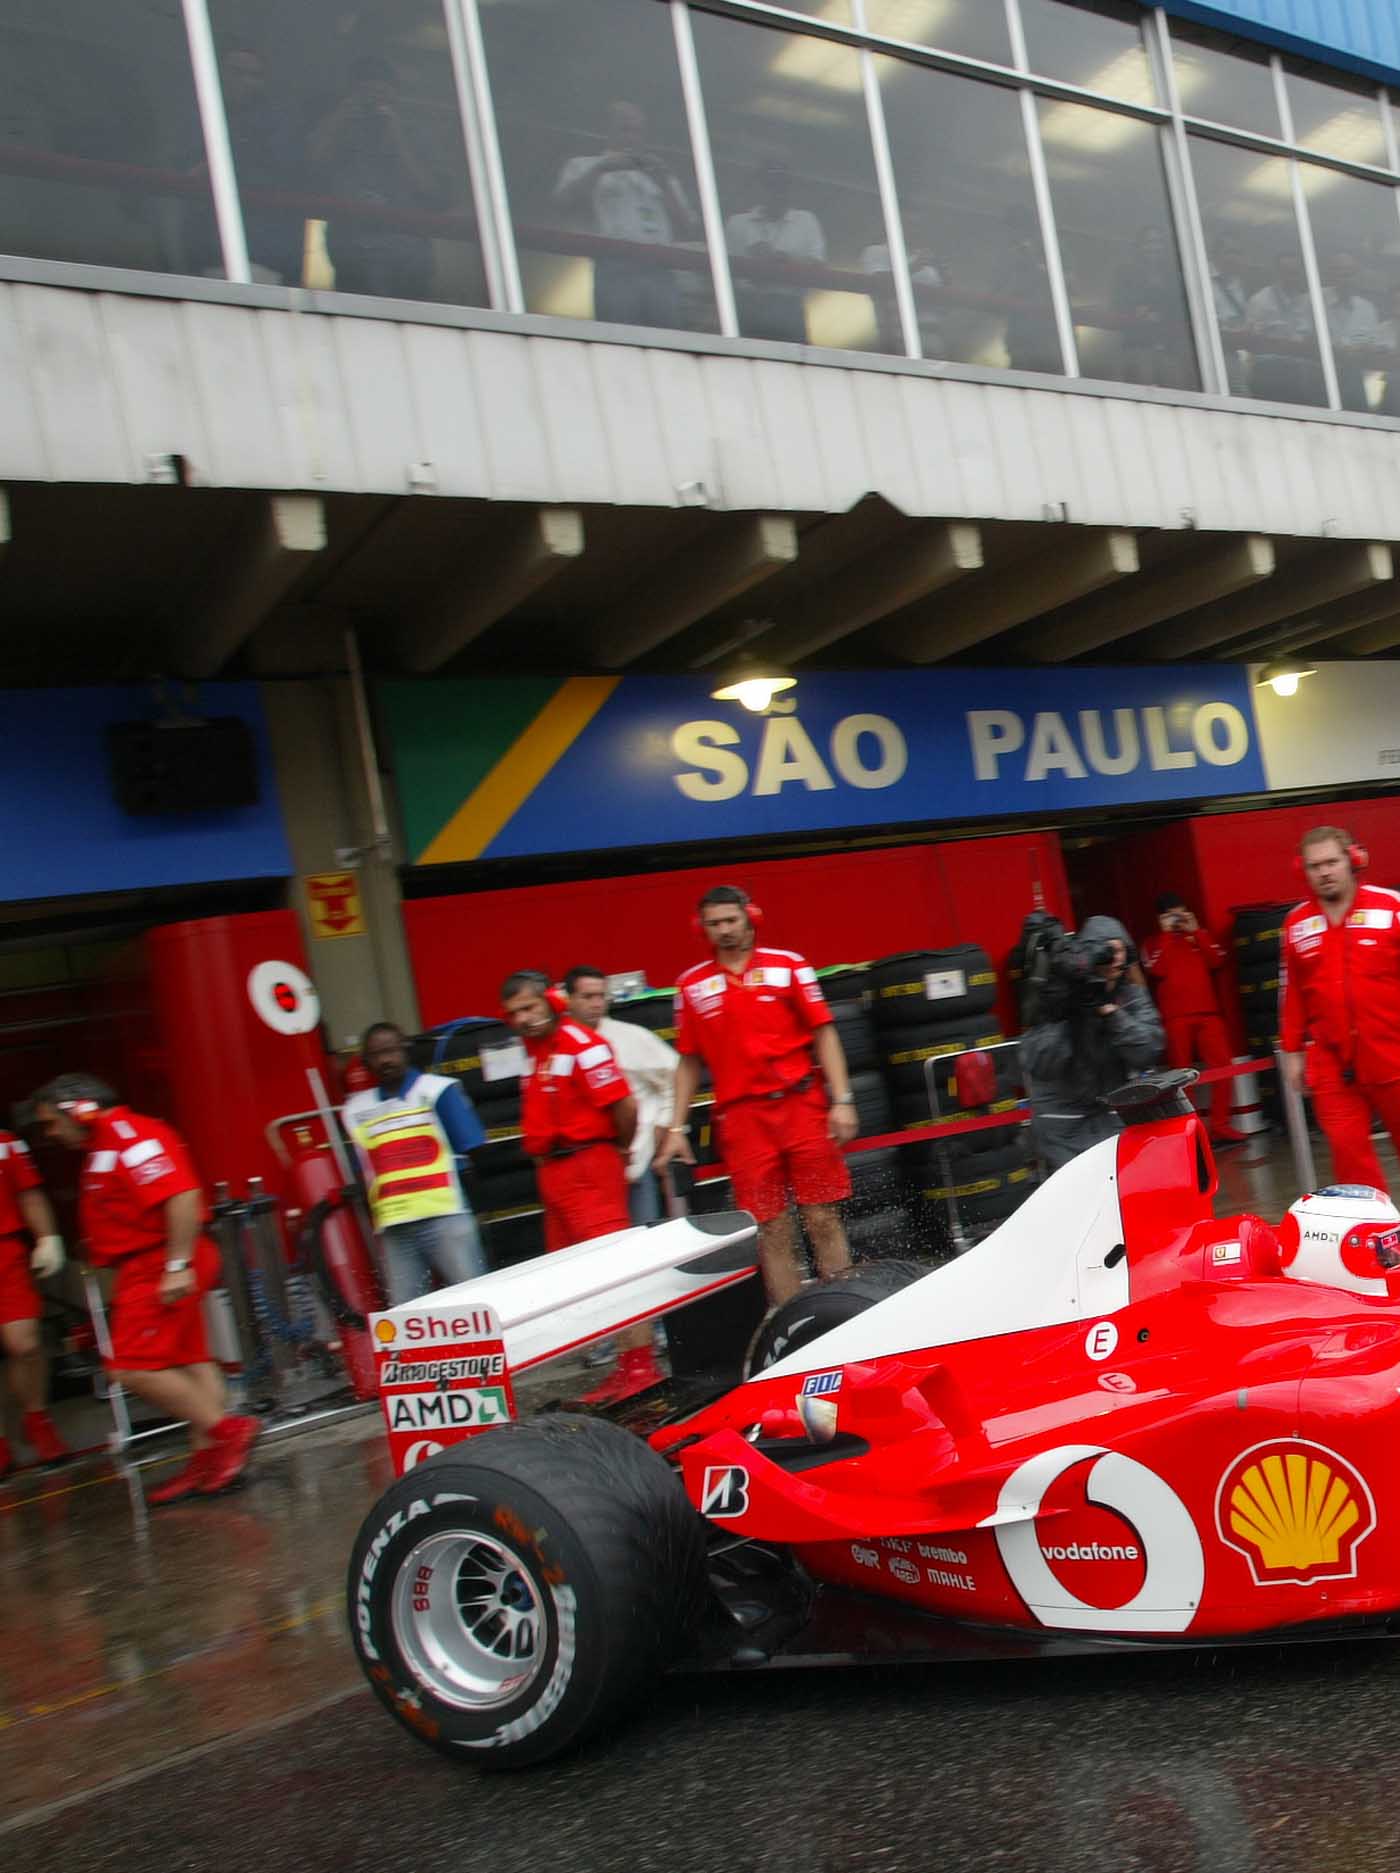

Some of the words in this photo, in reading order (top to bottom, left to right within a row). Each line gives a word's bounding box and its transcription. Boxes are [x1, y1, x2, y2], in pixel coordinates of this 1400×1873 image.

[671, 697, 908, 802] SÃO
[966, 702, 1249, 782] PAULO
[404, 1310, 493, 1341] Shell
[1093, 1328, 1110, 1354] E
[383, 1356, 503, 1385] BRIDGESTONE
[393, 1394, 473, 1429] AMD
[916, 1541, 969, 1565] brembo
[1040, 1541, 1139, 1560] vodafone
[357, 1499, 432, 1661] POTENZA
[413, 1565, 434, 1612] BBS
[926, 1567, 977, 1592] MAHLE
